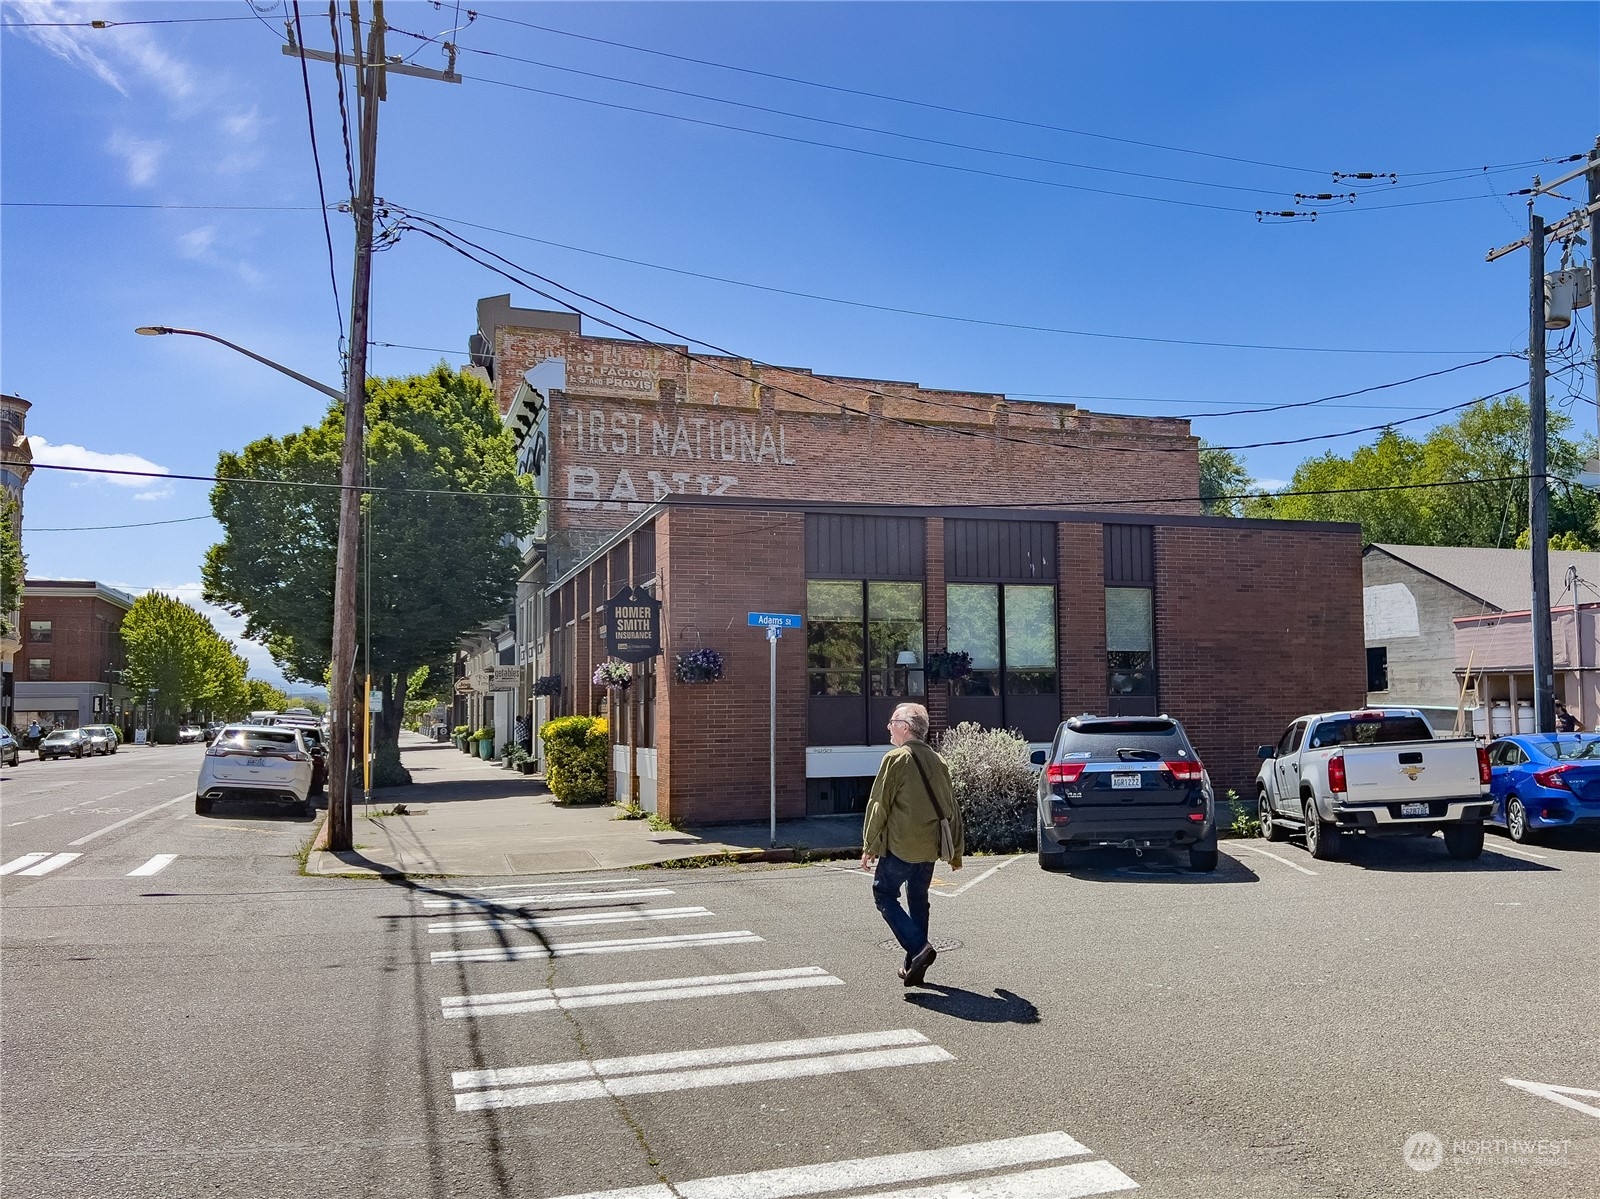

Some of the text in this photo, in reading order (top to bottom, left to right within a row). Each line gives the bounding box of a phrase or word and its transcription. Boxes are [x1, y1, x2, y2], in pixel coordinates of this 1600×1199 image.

[600, 365, 659, 379] FACTORY
[589, 377, 656, 391] AND PROVISI
[560, 409, 797, 466] FIRST NATIONAL
[615, 606, 651, 618] HOMER
[617, 619, 650, 631] SMITH
[758, 615, 783, 625] Adams
[615, 631, 652, 639] INSURANCE
[494, 668, 520, 679] getables
